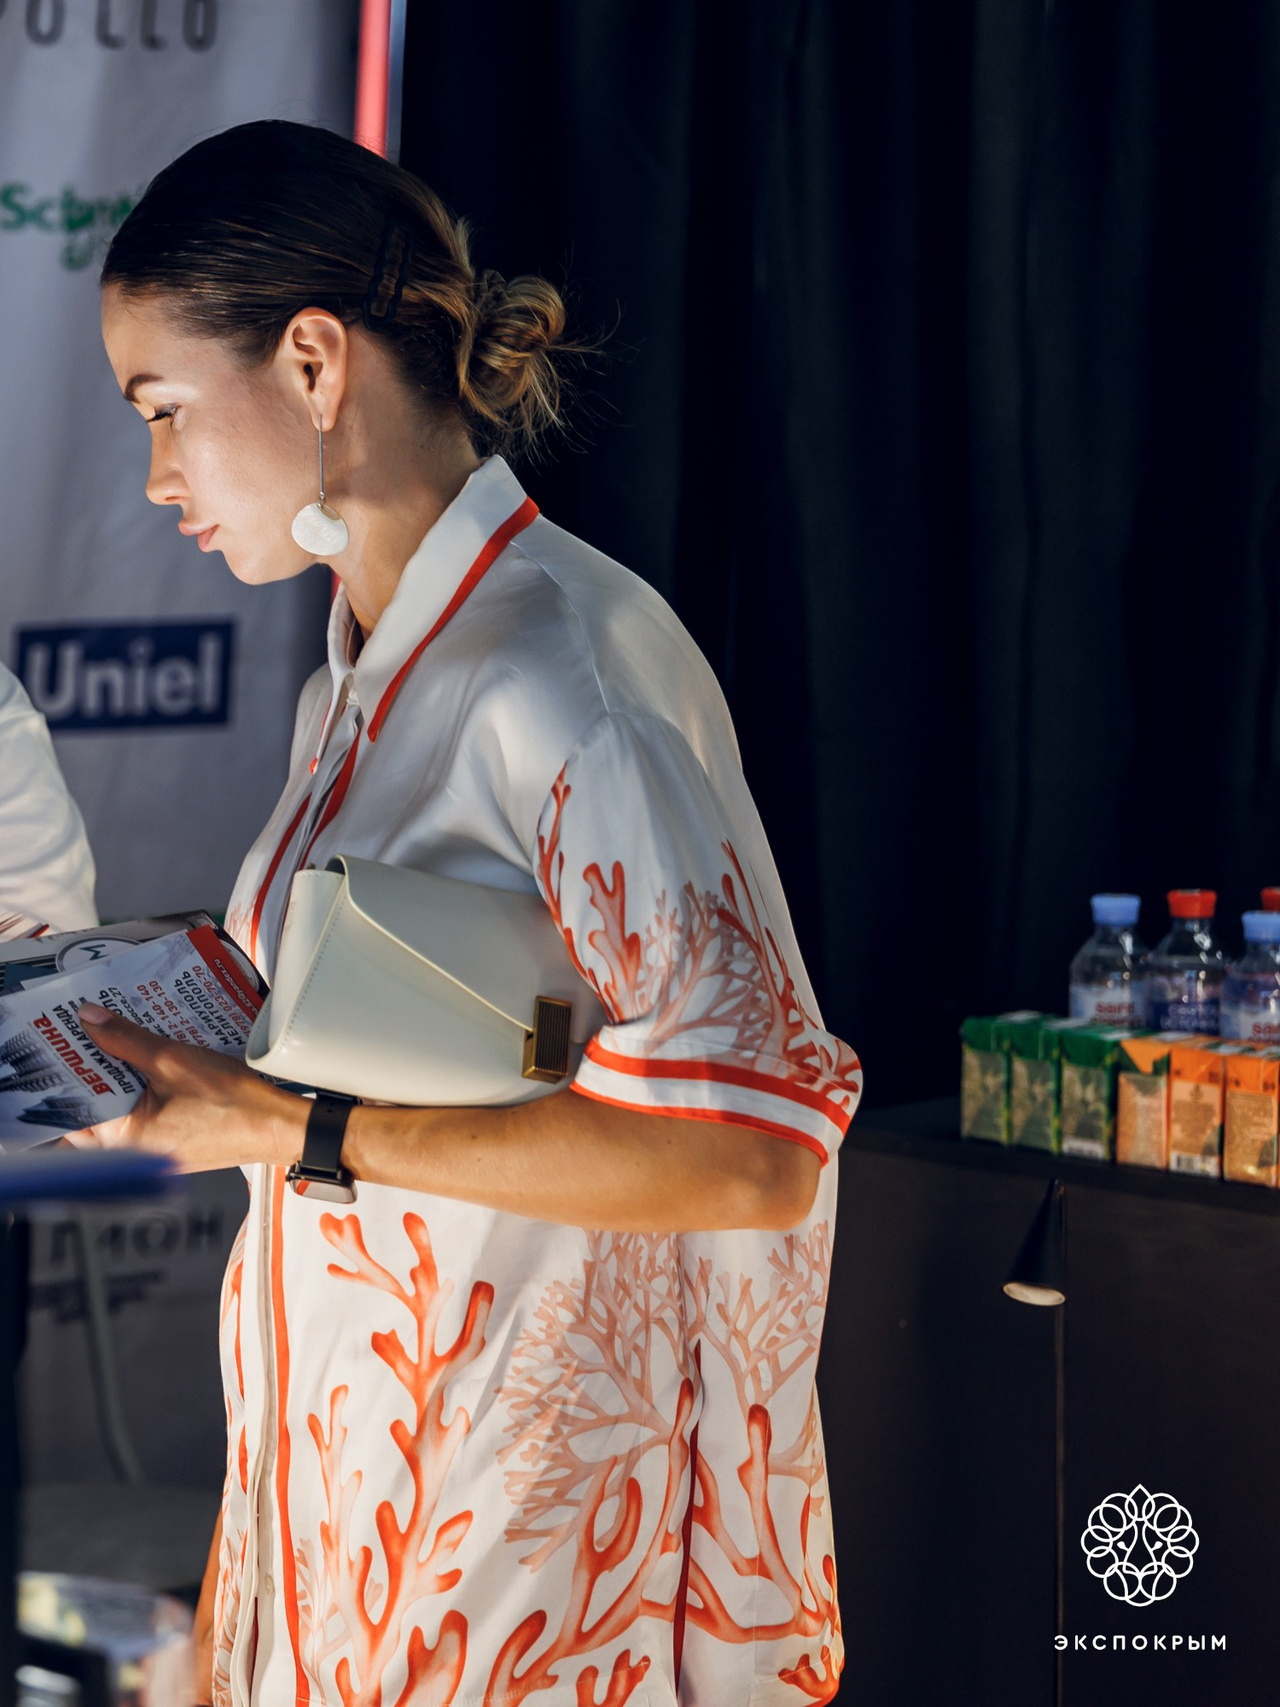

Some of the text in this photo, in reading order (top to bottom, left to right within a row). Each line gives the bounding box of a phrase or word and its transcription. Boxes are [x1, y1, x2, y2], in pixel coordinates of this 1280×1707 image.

[26, 632, 222, 722] Uniel
[137, 984, 178, 1030] 2-140-140
[149, 980, 190, 1026] 2-130-130
[180, 971, 245, 1046] МЕЛИТОПОЛЬ
[192, 965, 232, 1013] 023-70-70
[53, 1004, 89, 1040] АРЕНДА
[172, 979, 232, 1046] МАРИУПОЛЬ
[82, 1043, 94, 1051] И
[91, 1050, 135, 1094] ПРОДАЖА
